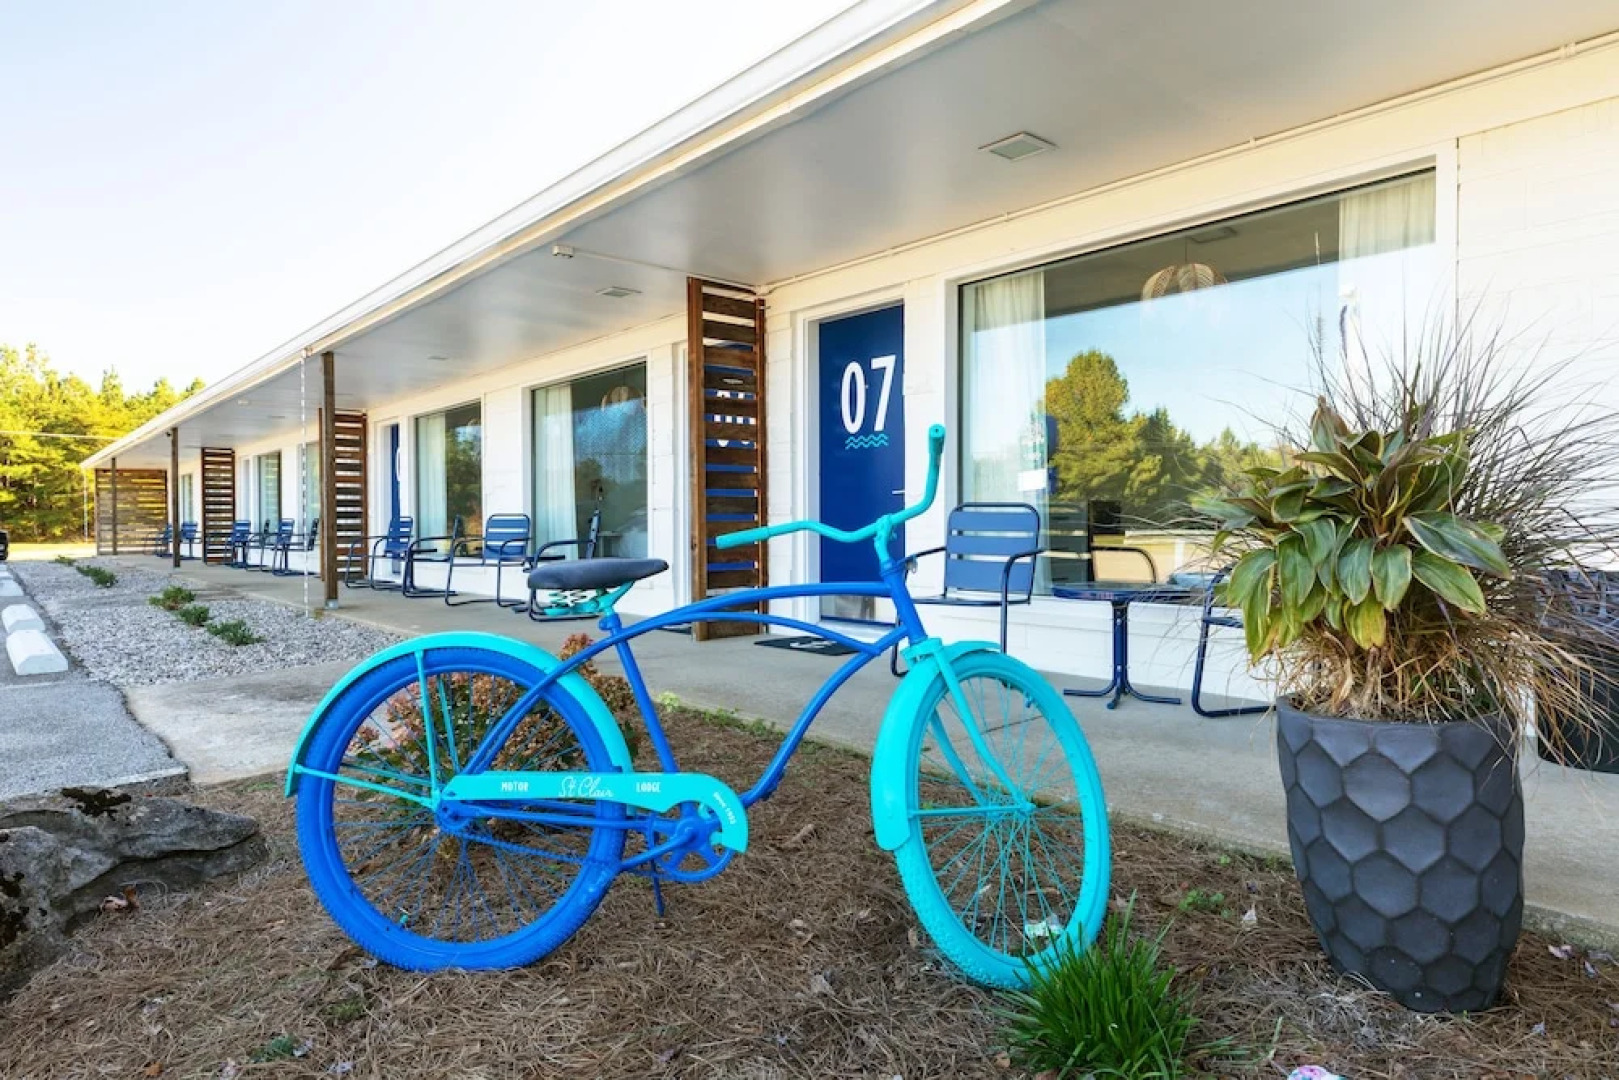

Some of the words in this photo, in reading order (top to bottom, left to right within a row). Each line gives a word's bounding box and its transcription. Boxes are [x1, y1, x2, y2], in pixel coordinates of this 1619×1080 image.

[841, 354, 897, 435] 07
[501, 781, 529, 793] MOTOR
[577, 776, 614, 798] Clair
[636, 781, 662, 793] LODGE
